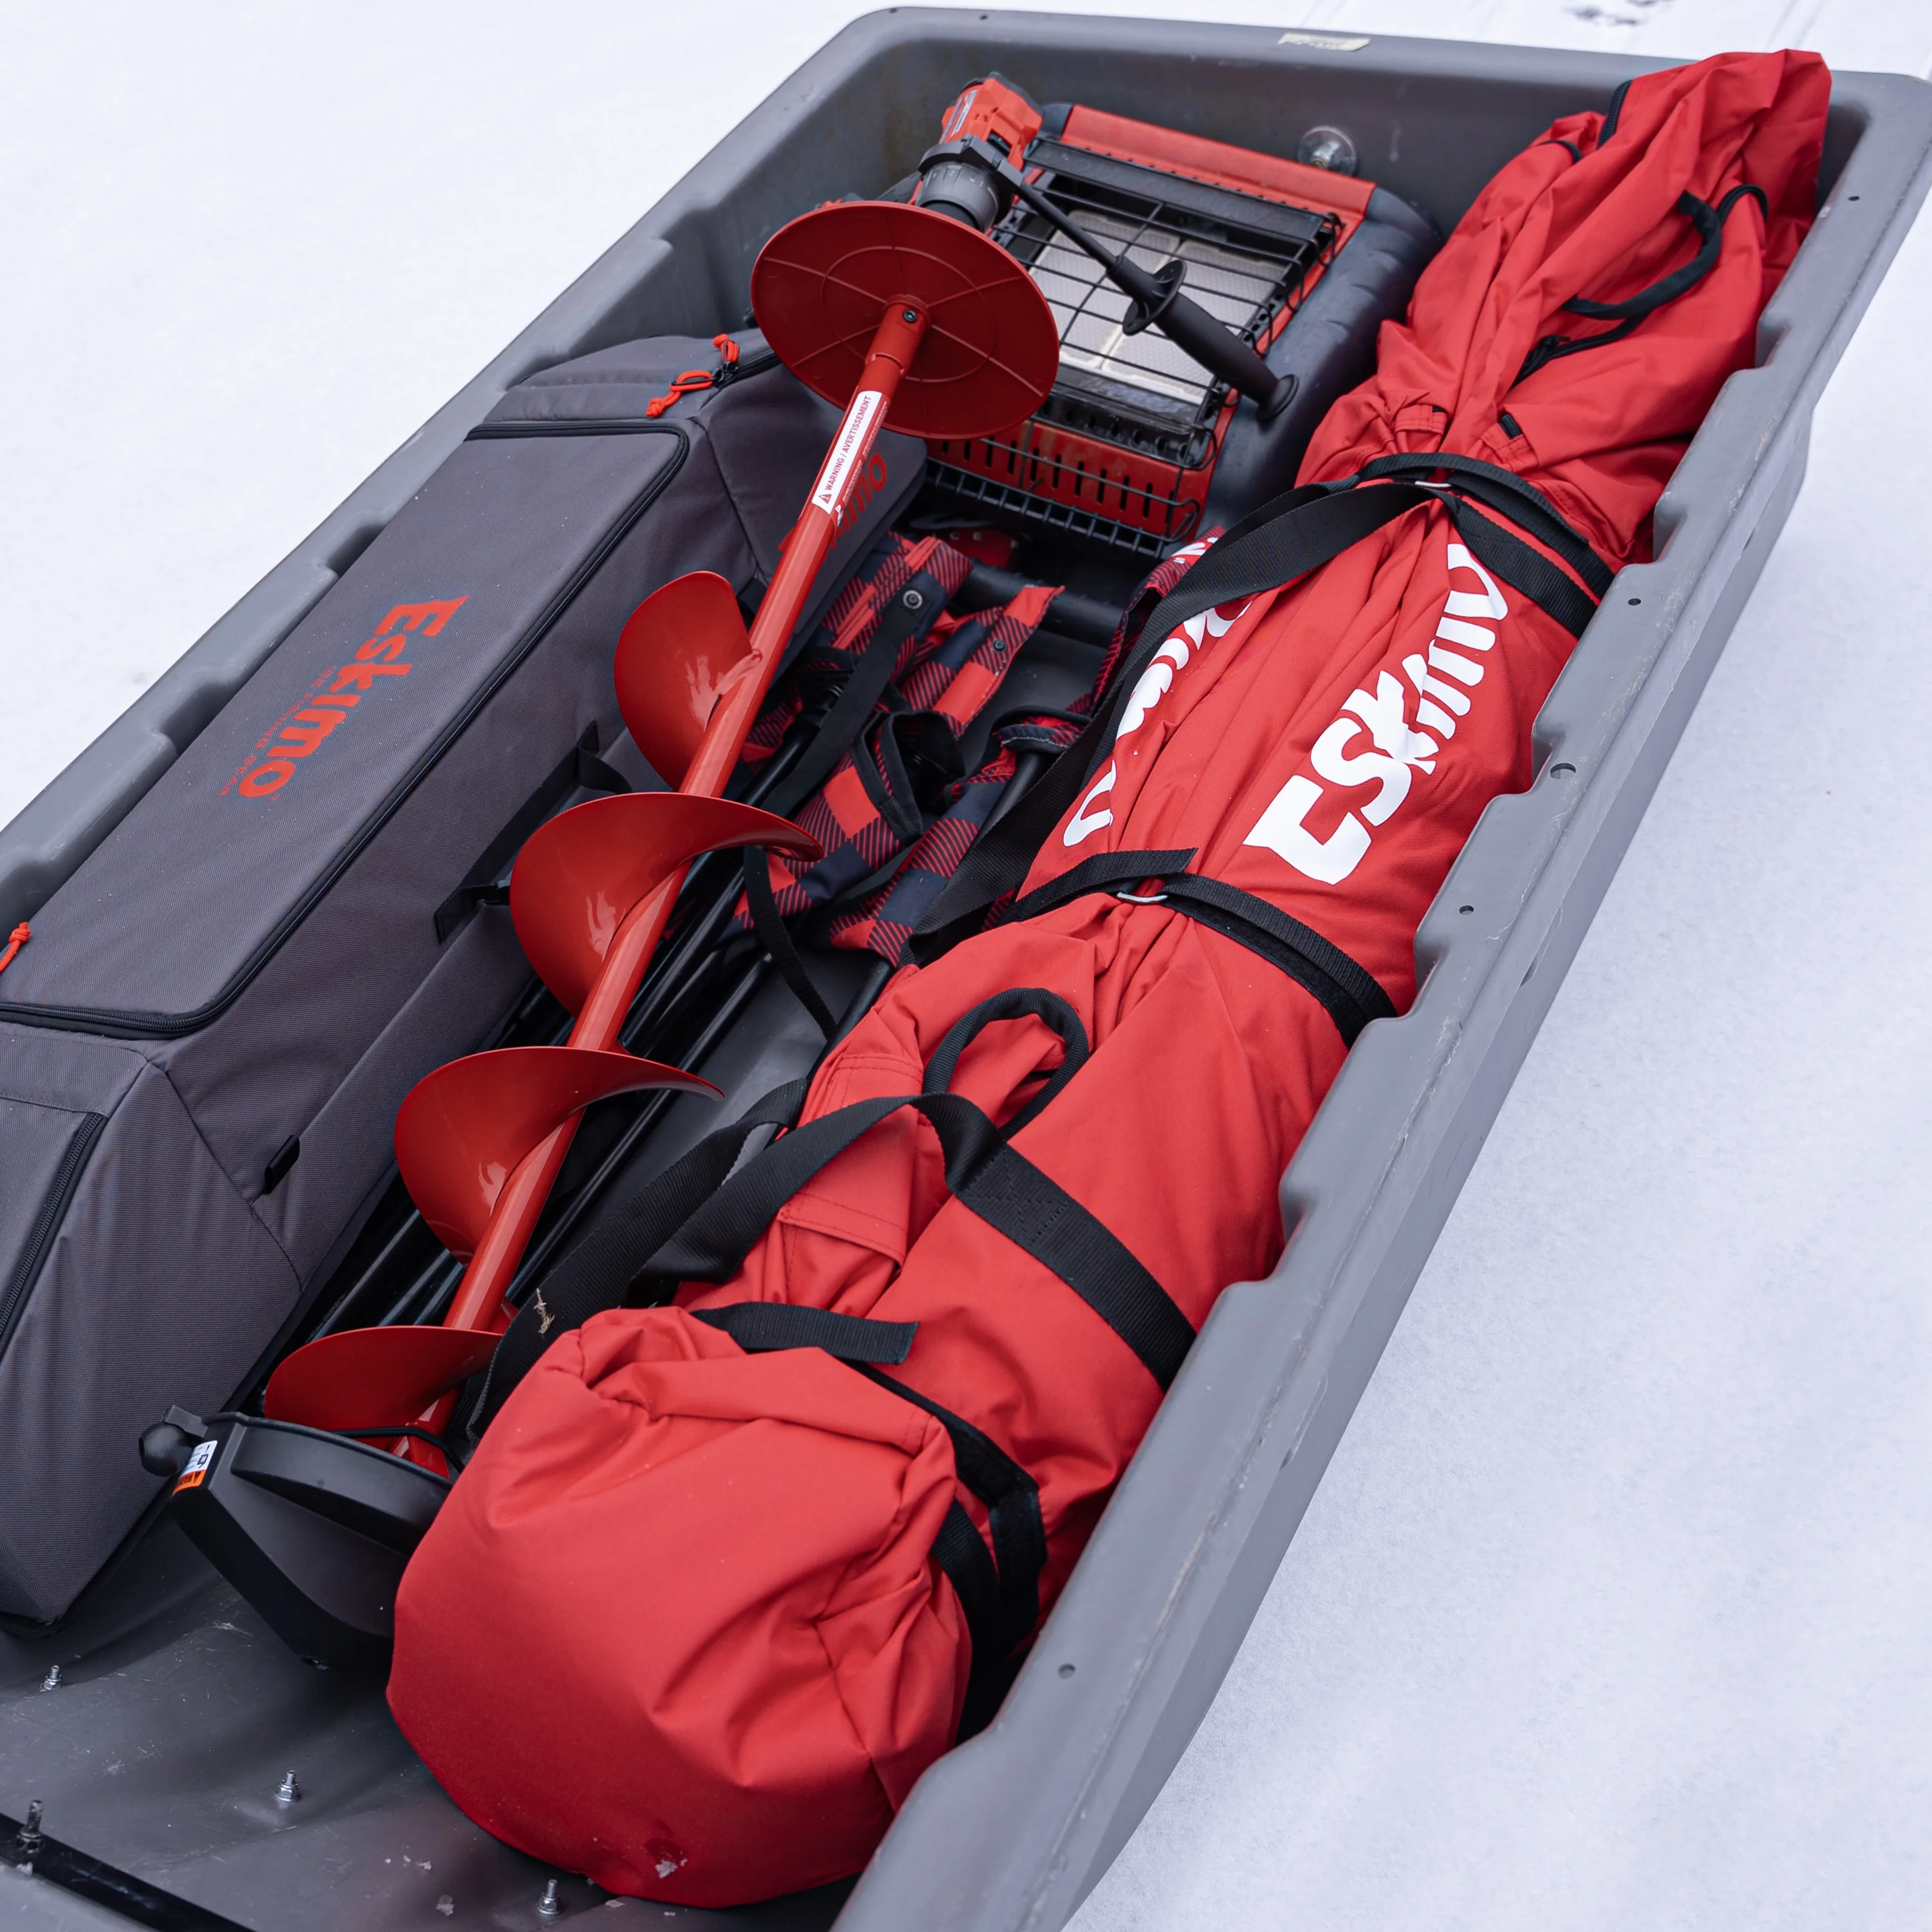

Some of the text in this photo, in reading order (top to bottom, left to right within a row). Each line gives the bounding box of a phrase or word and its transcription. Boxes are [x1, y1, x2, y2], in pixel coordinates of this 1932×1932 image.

[825, 457, 844, 491] WARNING
[842, 395, 871, 453] AVERTISSEMENT
[238, 595, 469, 797] Eskimo
